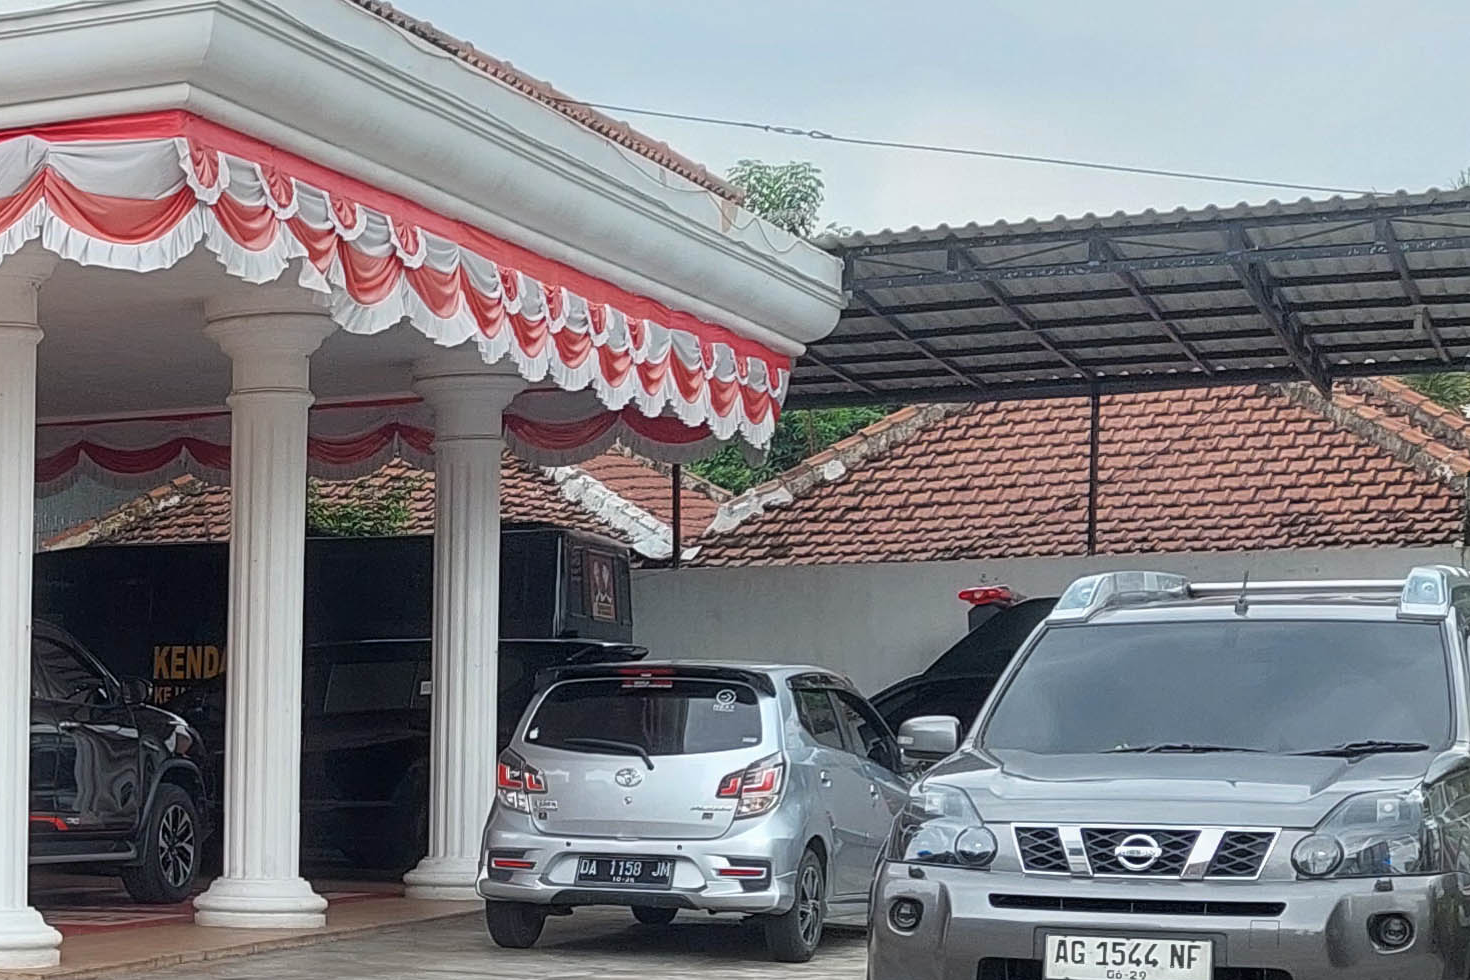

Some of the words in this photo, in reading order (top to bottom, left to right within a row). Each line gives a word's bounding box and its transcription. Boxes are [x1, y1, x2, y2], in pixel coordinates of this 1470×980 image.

[580, 859, 597, 876] DA
[609, 859, 642, 877] 1158
[651, 861, 671, 878] JM
[1054, 939, 1086, 965] AG
[1095, 941, 1160, 968] 1544
[1169, 943, 1202, 970] NF
[1106, 969, 1147, 980] 06-29
